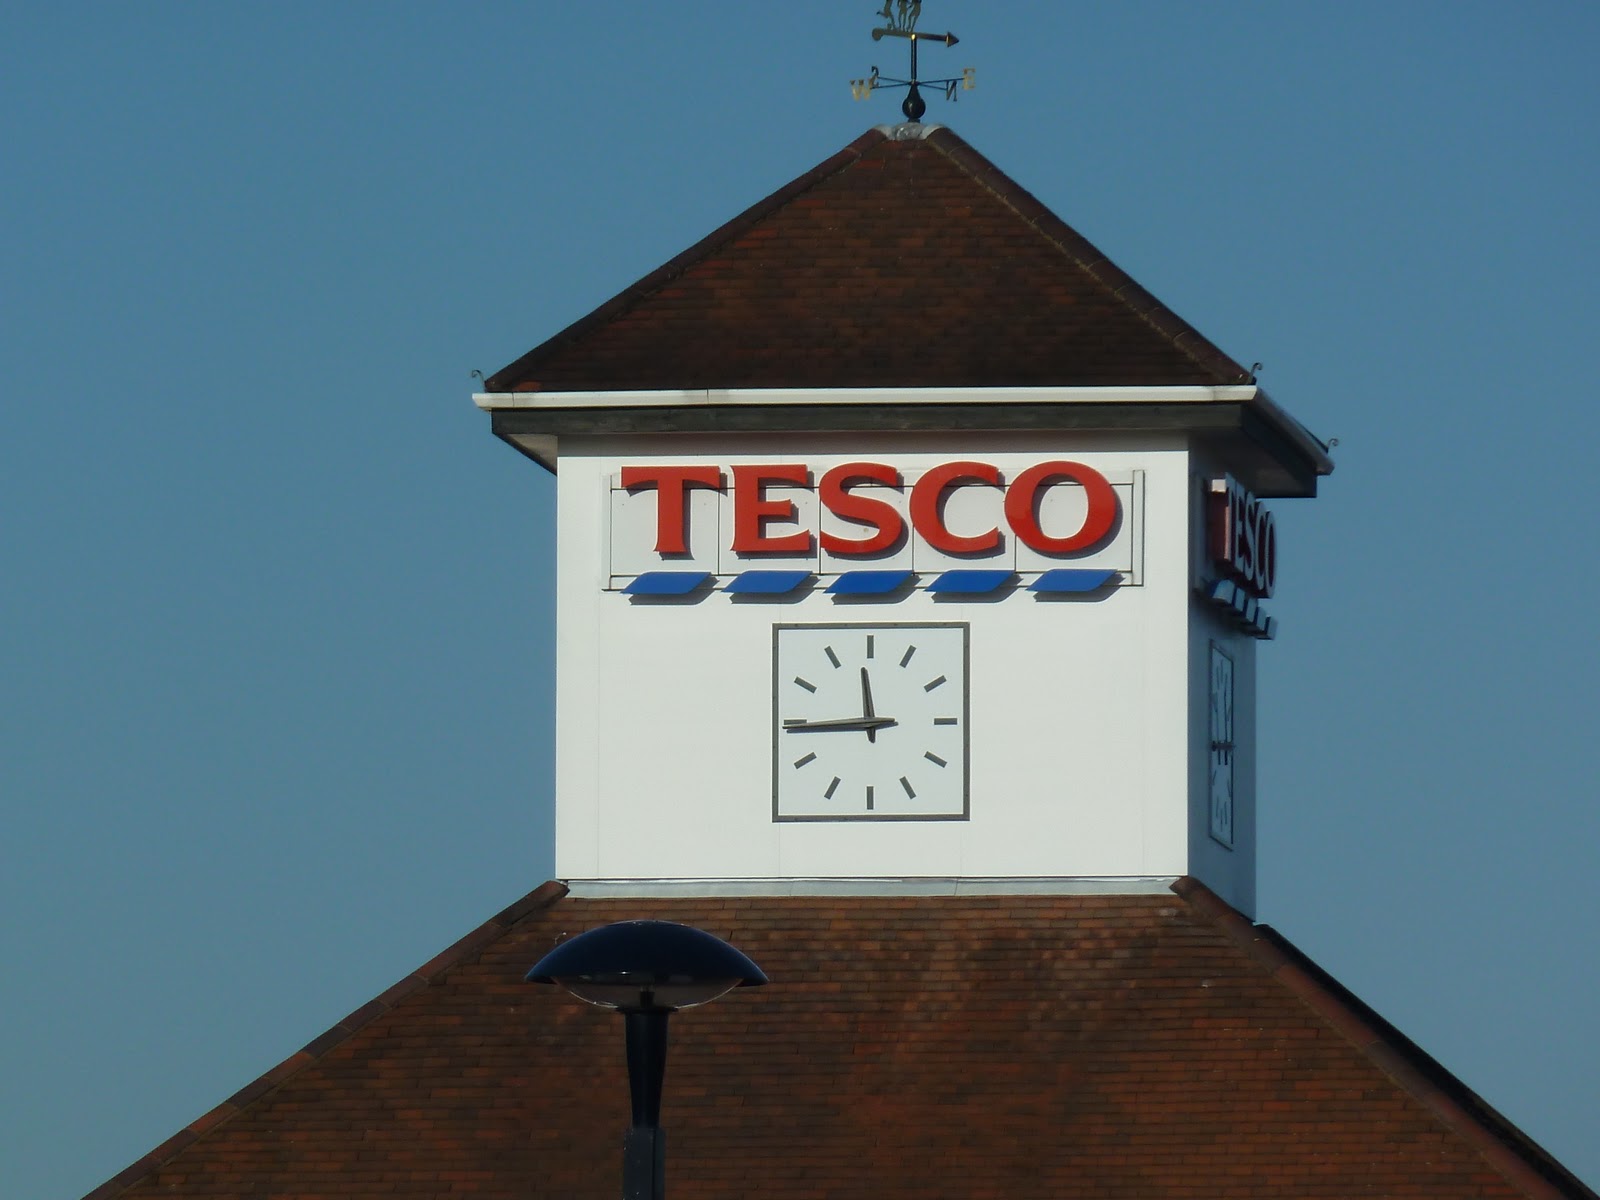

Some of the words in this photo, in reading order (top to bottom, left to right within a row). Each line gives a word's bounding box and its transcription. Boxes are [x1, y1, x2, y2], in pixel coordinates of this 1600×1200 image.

[850, 79, 873, 102] W
[963, 68, 976, 90] E
[621, 460, 1117, 553] TESCO
[1211, 472, 1276, 599] TESCO
